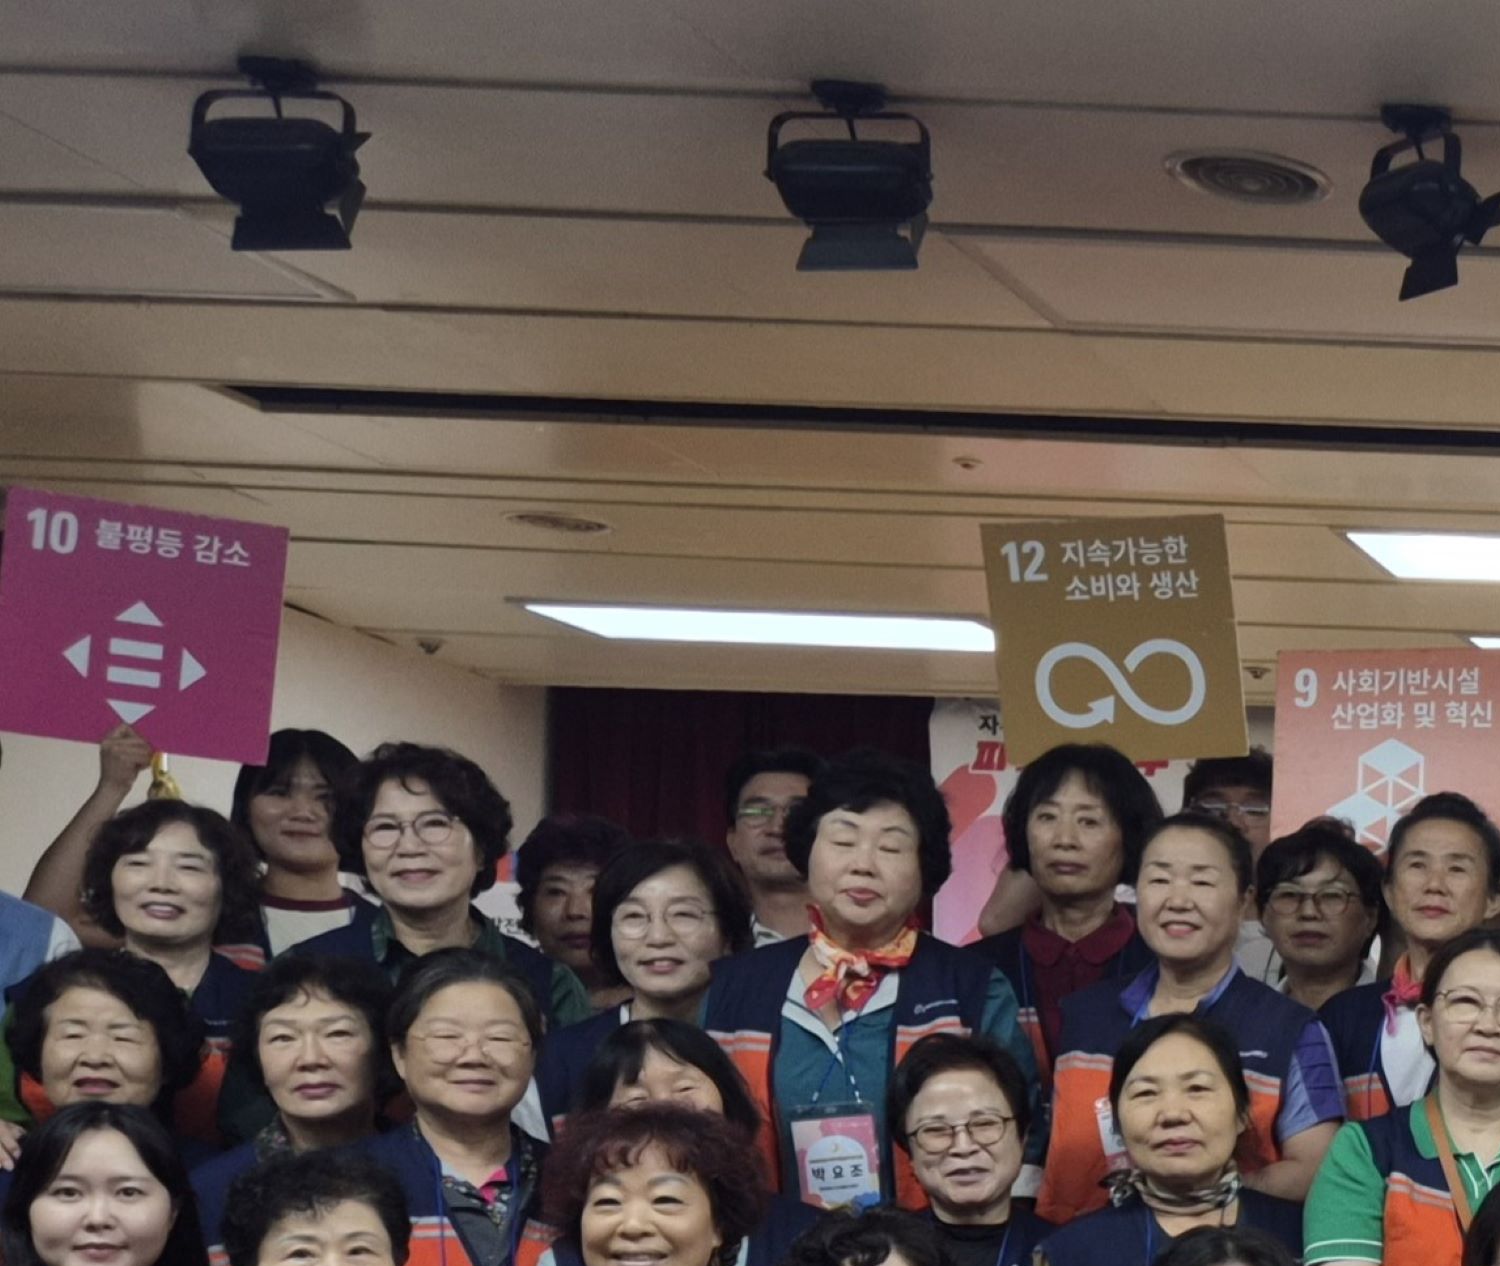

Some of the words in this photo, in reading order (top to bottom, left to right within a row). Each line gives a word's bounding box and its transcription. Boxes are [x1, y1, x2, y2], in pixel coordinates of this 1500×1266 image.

[27, 508, 79, 554] 10
[95, 519, 184, 558] 불평등
[194, 535, 251, 567] 감소
[1001, 540, 1048, 582] 12
[1060, 536, 1188, 568] 지속가능한
[1065, 573, 1141, 601] 소비와
[1149, 570, 1199, 600] 생산
[1294, 668, 1318, 707] 9
[1332, 668, 1480, 696] 사회기반시설
[1331, 702, 1404, 730] 산업화
[1414, 702, 1435, 729] 및
[1445, 701, 1492, 728] 혁신
